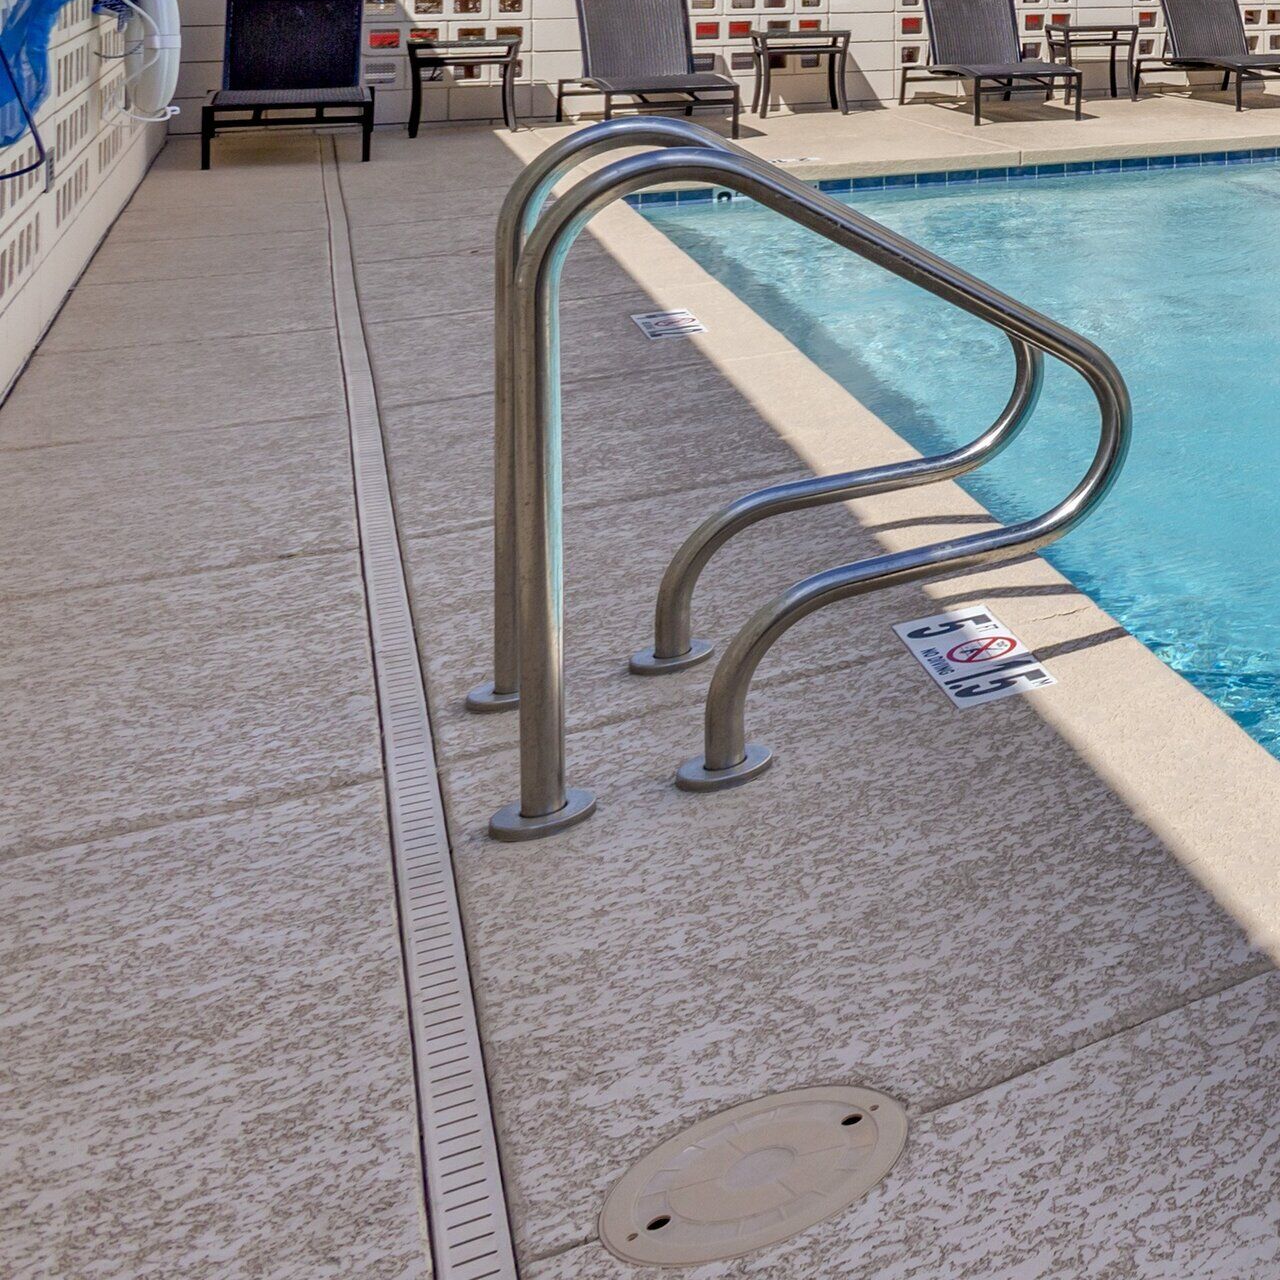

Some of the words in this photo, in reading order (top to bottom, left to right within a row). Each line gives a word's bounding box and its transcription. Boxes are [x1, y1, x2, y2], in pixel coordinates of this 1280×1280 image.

[907, 613, 992, 639] 5
[927, 654, 955, 676] DIVING
[944, 660, 1047, 699] 1.5
